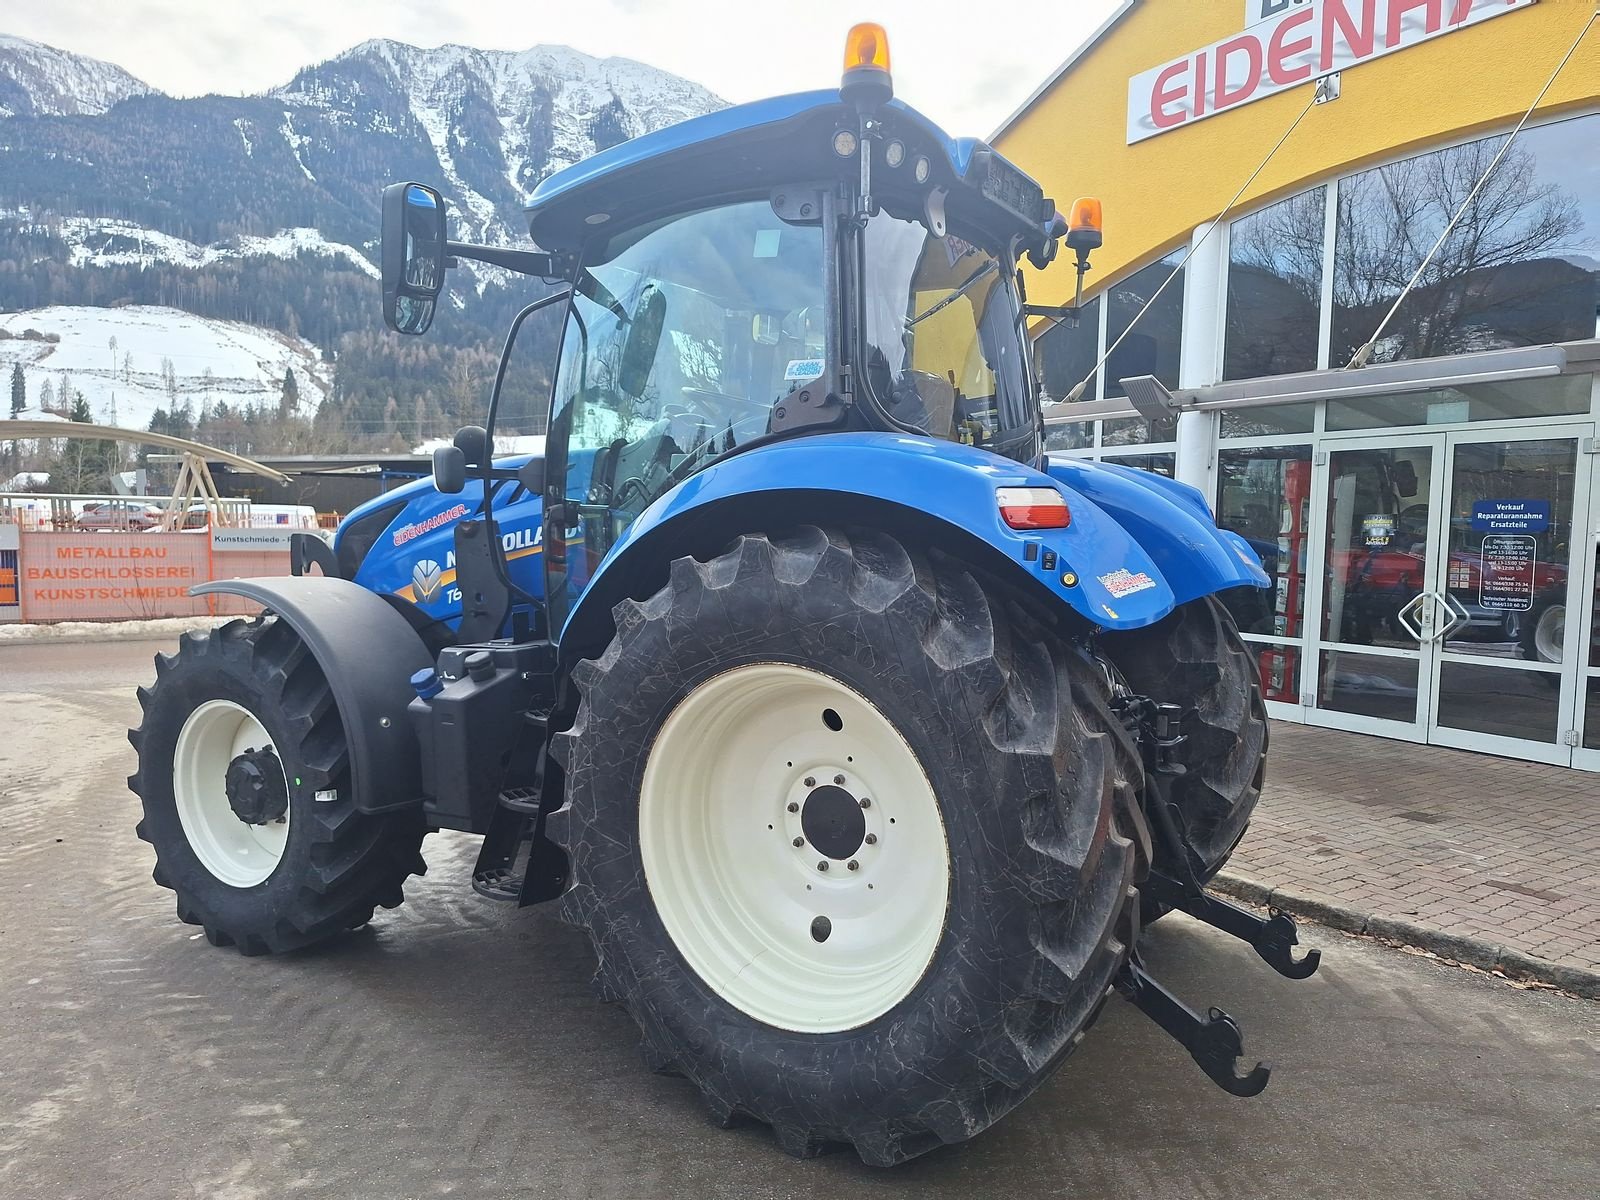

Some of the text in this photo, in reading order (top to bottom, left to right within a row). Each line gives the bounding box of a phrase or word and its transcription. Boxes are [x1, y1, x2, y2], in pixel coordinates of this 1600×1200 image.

[1496, 503, 1524, 511] Verkauf
[1477, 512, 1543, 520] Reparaturannahme
[394, 504, 466, 546] EIDENHAMMER
[1490, 521, 1528, 529] Ersatzteile
[214, 535, 280, 543] Kunstschmiede
[56, 546, 168, 559] METALLBAU
[27, 566, 195, 580] BAUSCHLOSSEREI
[34, 586, 190, 600] KUNSTSCHMIEDE
